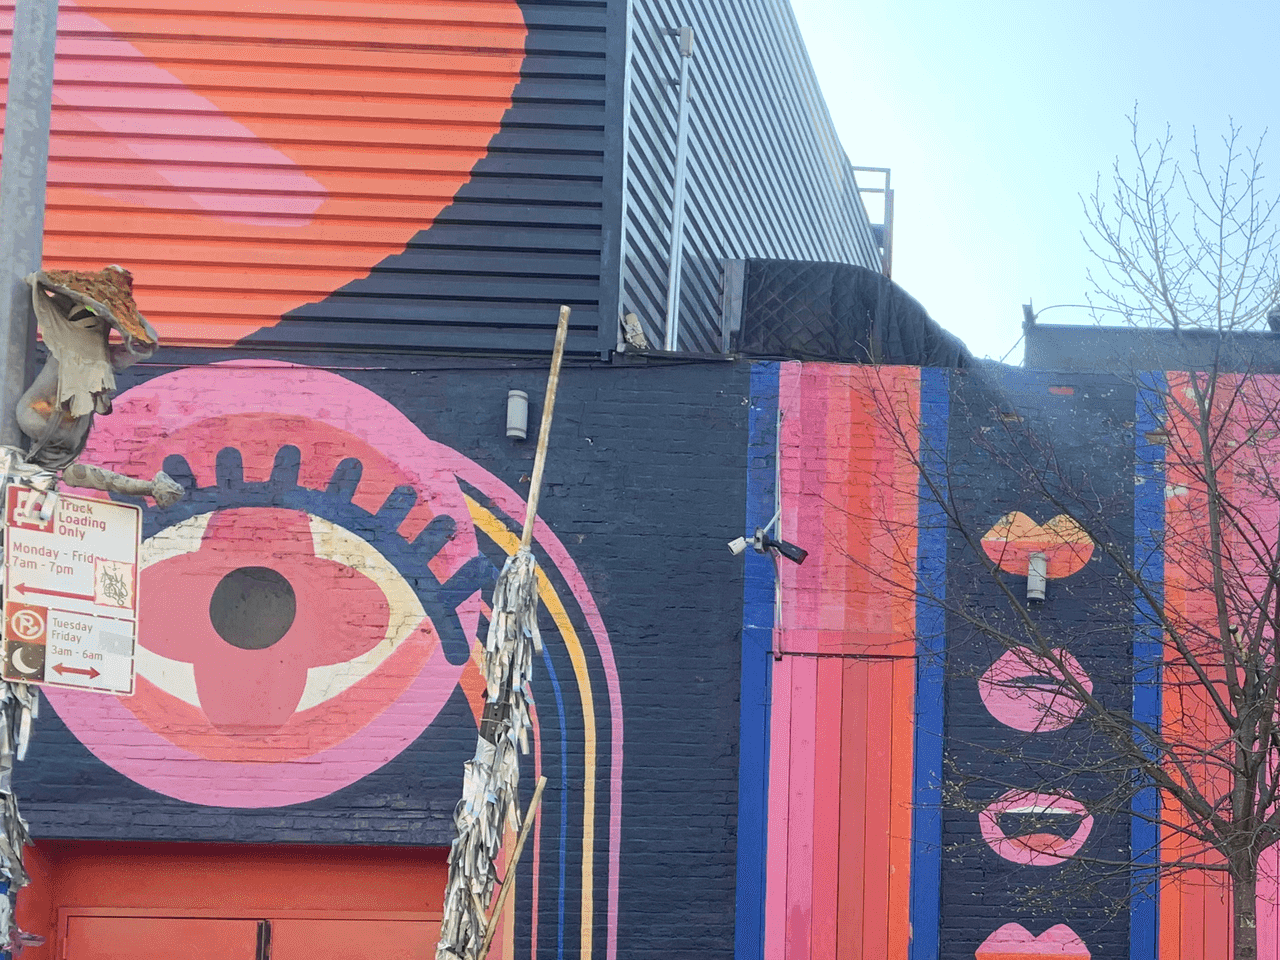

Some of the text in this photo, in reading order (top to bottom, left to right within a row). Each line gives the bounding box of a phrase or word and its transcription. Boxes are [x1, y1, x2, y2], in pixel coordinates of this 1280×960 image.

[60, 499, 93, 515] Truck
[59, 512, 106, 531] Loading
[59, 525, 85, 541] Only
[13, 542, 59, 560] Monday
[72, 550, 107, 564] Frid
[12, 555, 38, 569] 7am
[49, 561, 74, 575] 7pm
[52, 617, 93, 634] Tuesday
[51, 629, 82, 644] Friday
[51, 644, 72, 657] 3am
[82, 649, 103, 661] 6am
